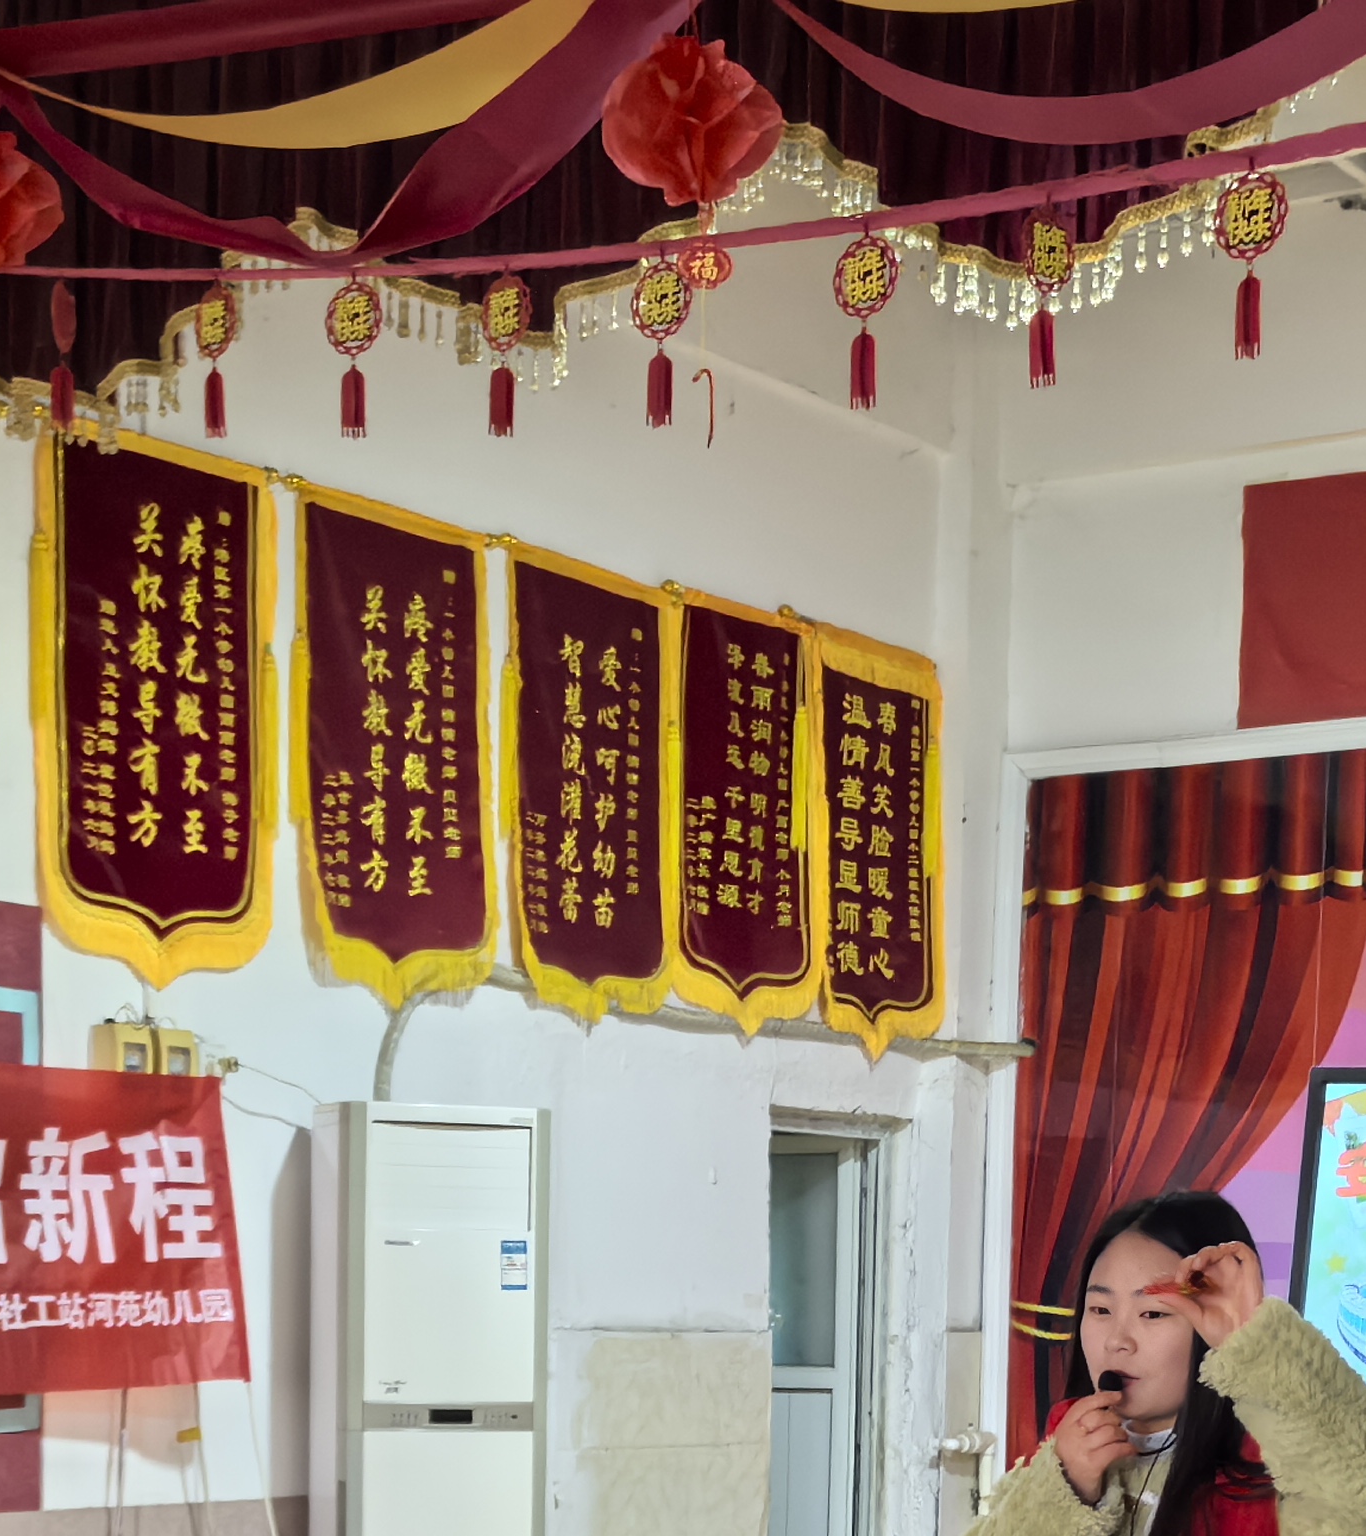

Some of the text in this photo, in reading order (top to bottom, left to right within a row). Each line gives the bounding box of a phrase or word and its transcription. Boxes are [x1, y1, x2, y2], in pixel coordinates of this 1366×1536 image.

[691, 252, 718, 280] 福
[835, 693, 872, 977] 温情善导显师德
[867, 701, 895, 980] 春风笑脸暖童心
